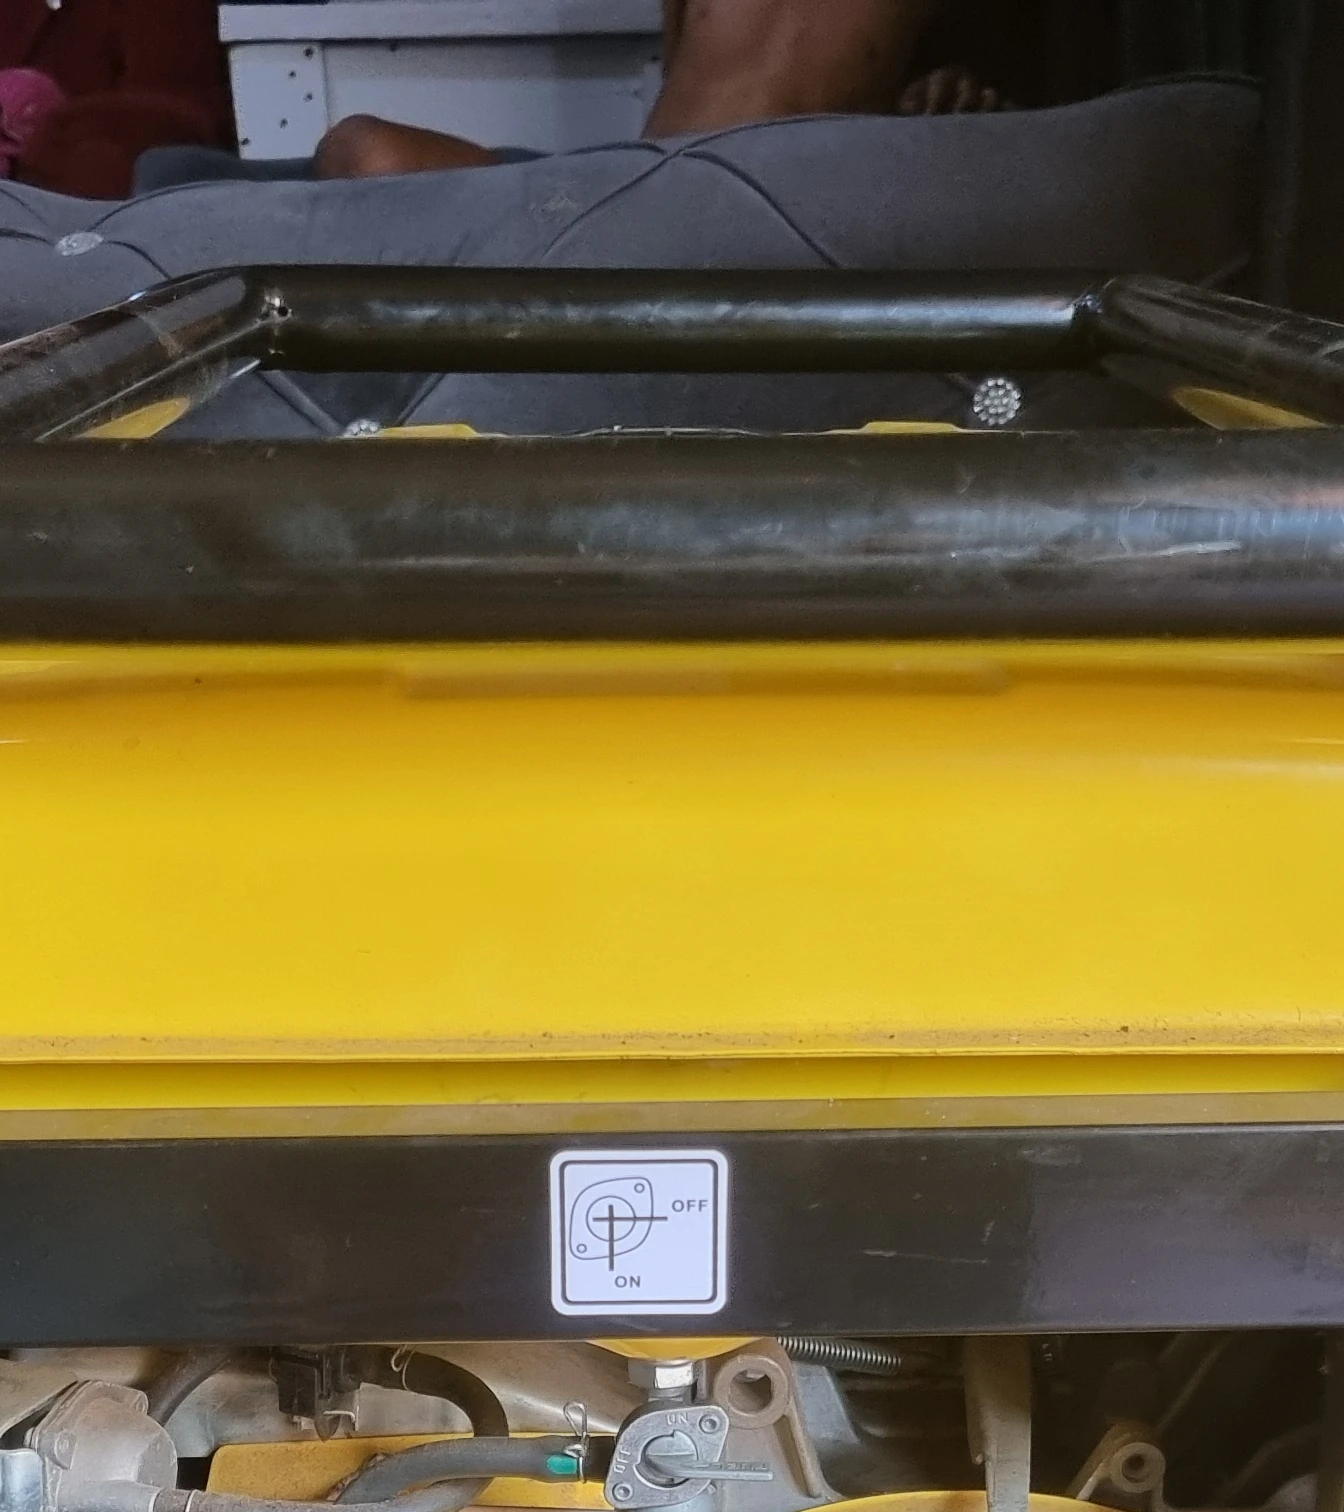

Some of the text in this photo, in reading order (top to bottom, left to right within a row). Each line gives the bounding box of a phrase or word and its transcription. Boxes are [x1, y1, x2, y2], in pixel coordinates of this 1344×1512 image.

[671, 1199, 708, 1213] OFF
[614, 1275, 641, 1288] ON
[666, 1413, 689, 1426] ON
[613, 1444, 631, 1474] OFF
